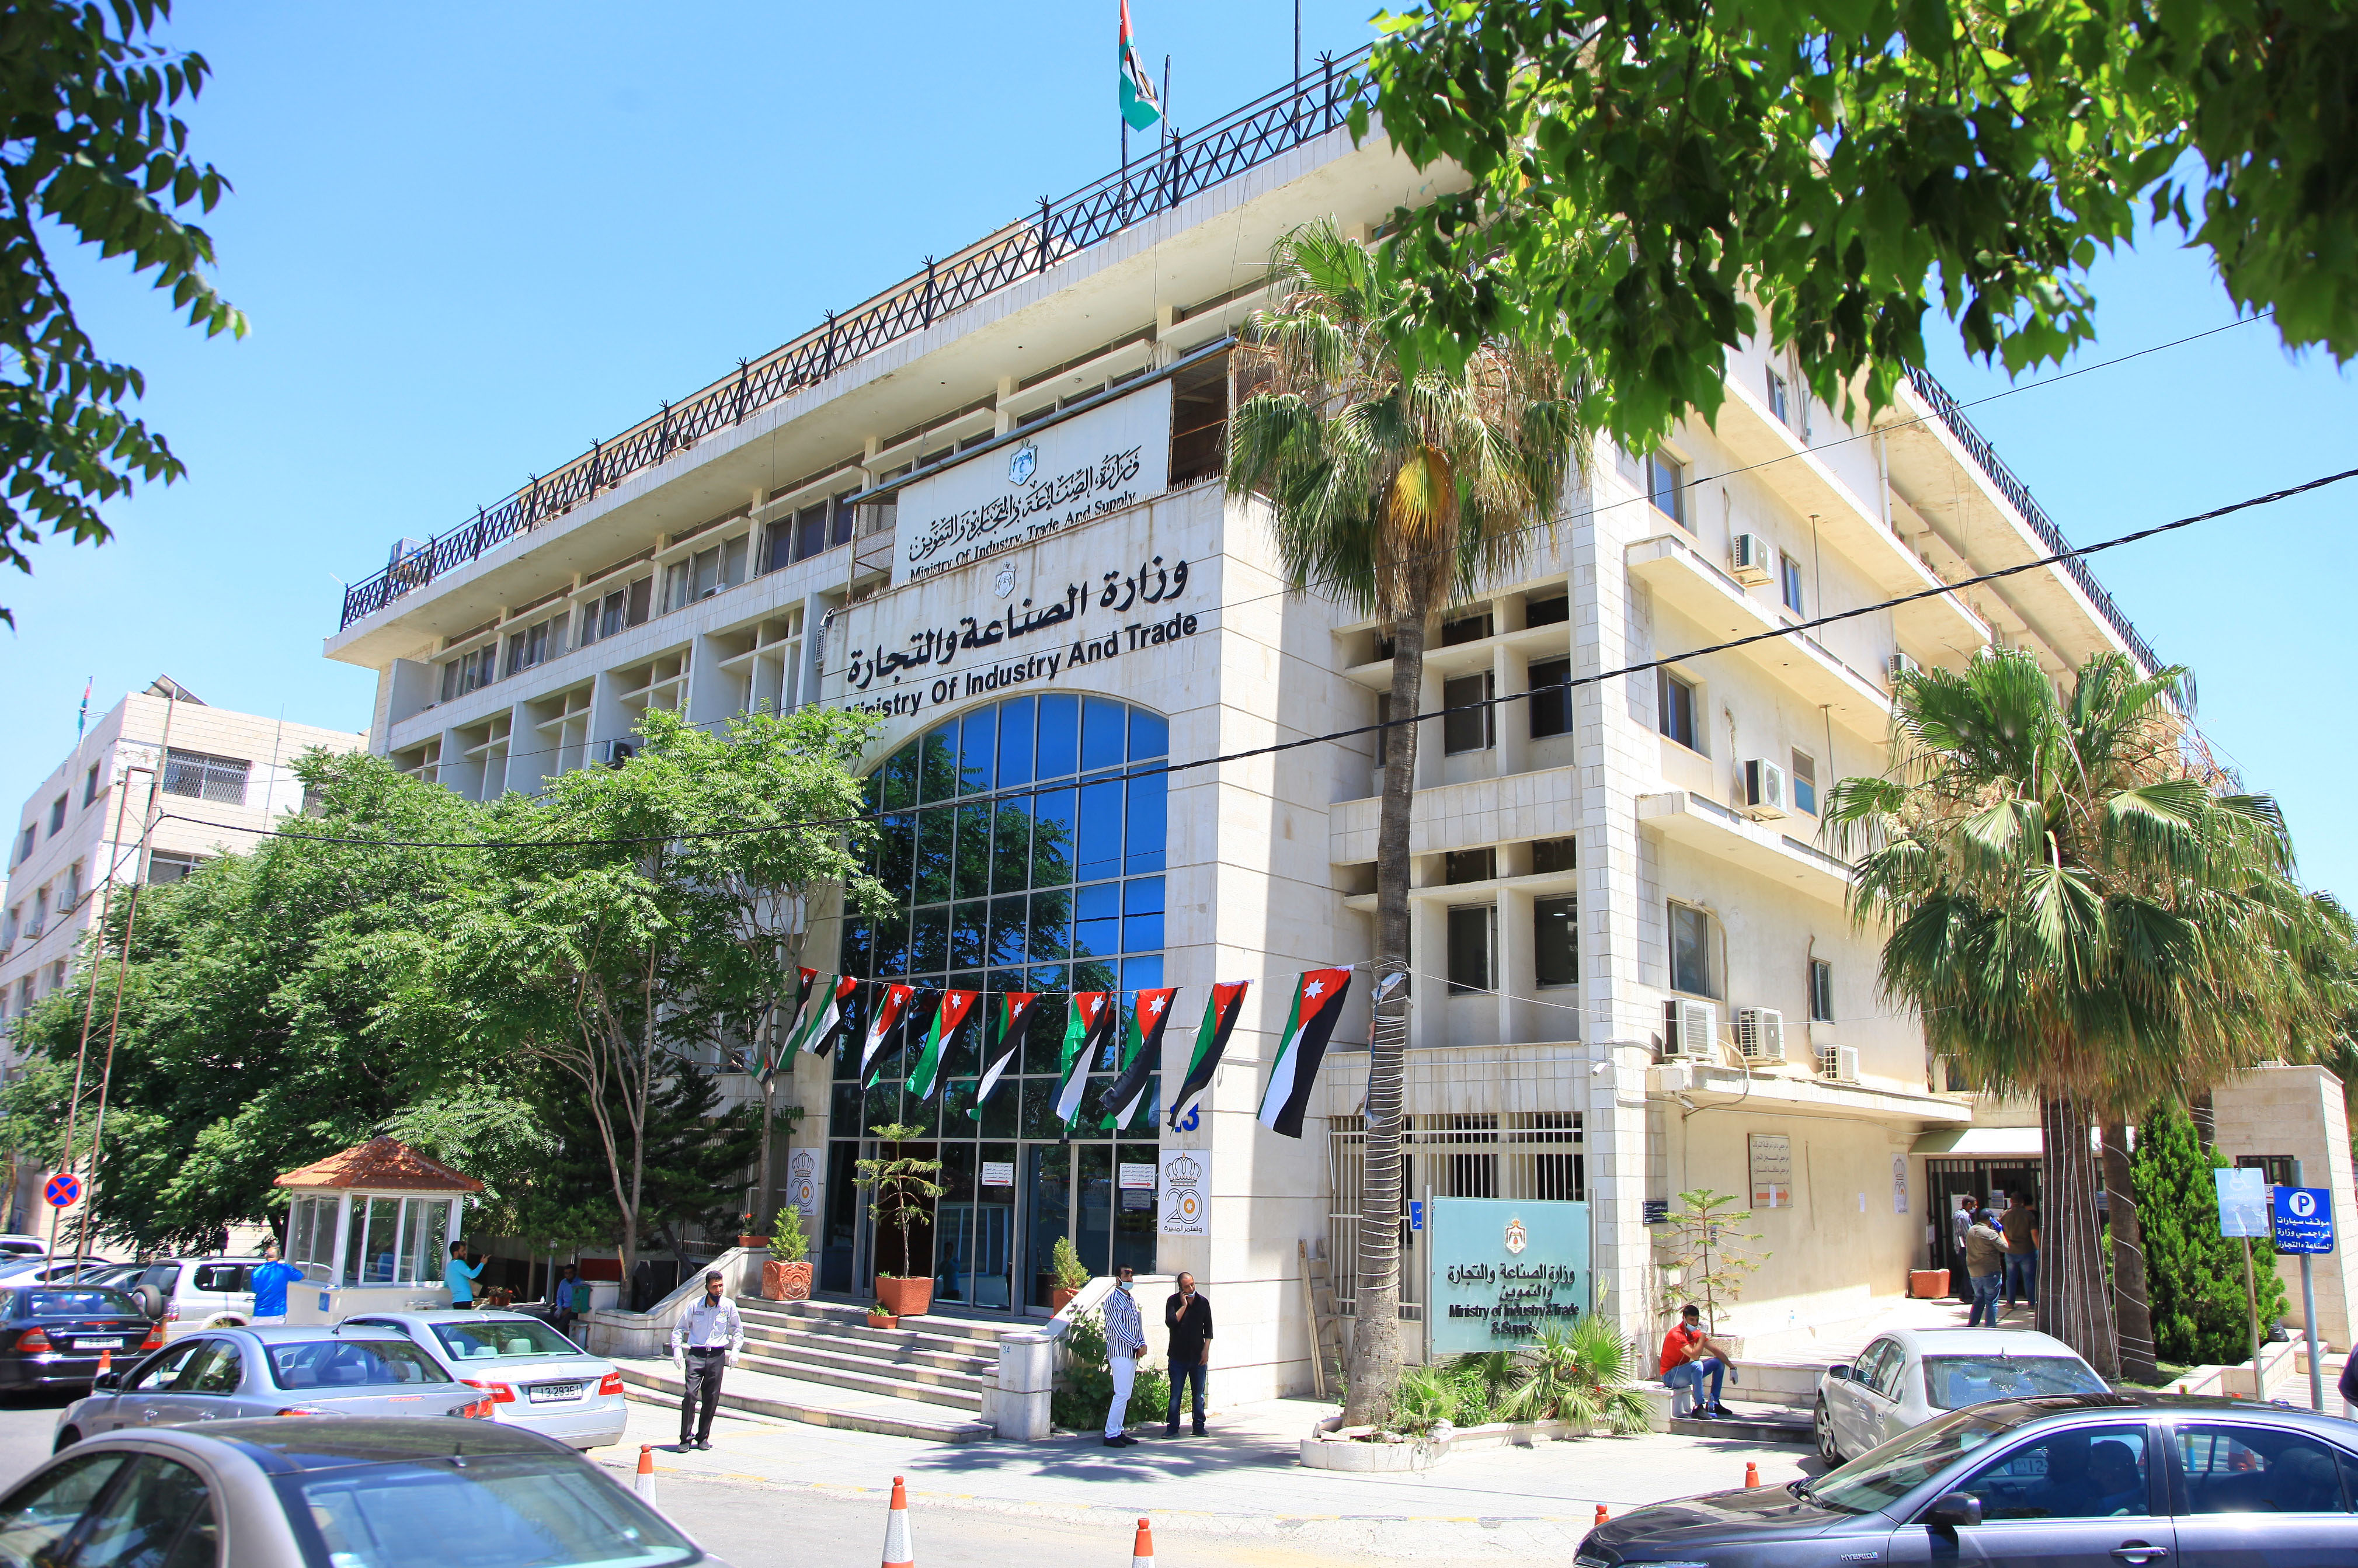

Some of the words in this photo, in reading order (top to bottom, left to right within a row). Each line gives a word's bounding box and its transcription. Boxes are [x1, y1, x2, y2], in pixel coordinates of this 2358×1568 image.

[1095, 445, 1142, 491] وزارة
[1023, 466, 1093, 517] الصناعة
[966, 494, 1022, 541] والتجارة
[910, 559, 953, 582] Ministry
[955, 548, 972, 565] Of
[1027, 518, 1059, 540] Trade
[1065, 505, 1091, 526] And
[1094, 491, 1137, 516] Supply
[1100, 556, 1188, 613] وزارة
[960, 581, 1087, 649] الصناعة
[847, 627, 957, 689] والتجارة
[931, 676, 958, 704] Of
[965, 652, 1061, 696] Industry
[1067, 631, 1119, 669] And
[1125, 611, 1198, 651] Trade
[1164, 1188, 1203, 1225] 20
[2297, 1195, 2310, 1213] P
[1164, 1224, 1184, 1233] المسيرة
[1184, 1225, 1202, 1233] وتستمر
[2276, 1216, 2304, 1226] سيارات
[2304, 1218, 2329, 1228] موقف
[2277, 1228, 2294, 1237] وزارة
[2296, 1230, 2332, 1239] لمراجعي
[1448, 1263, 1496, 1286] والتجارة
[1499, 1262, 1547, 1280] الصناعة
[1548, 1263, 1576, 1284] وزارة
[1499, 1283, 1553, 1302] والتموين
[1449, 1304, 1490, 1320] Ministry
[1491, 1304, 1503, 1317] of
[1504, 1303, 1546, 1319] Industry
[1003, 1345, 1010, 1354] 34
